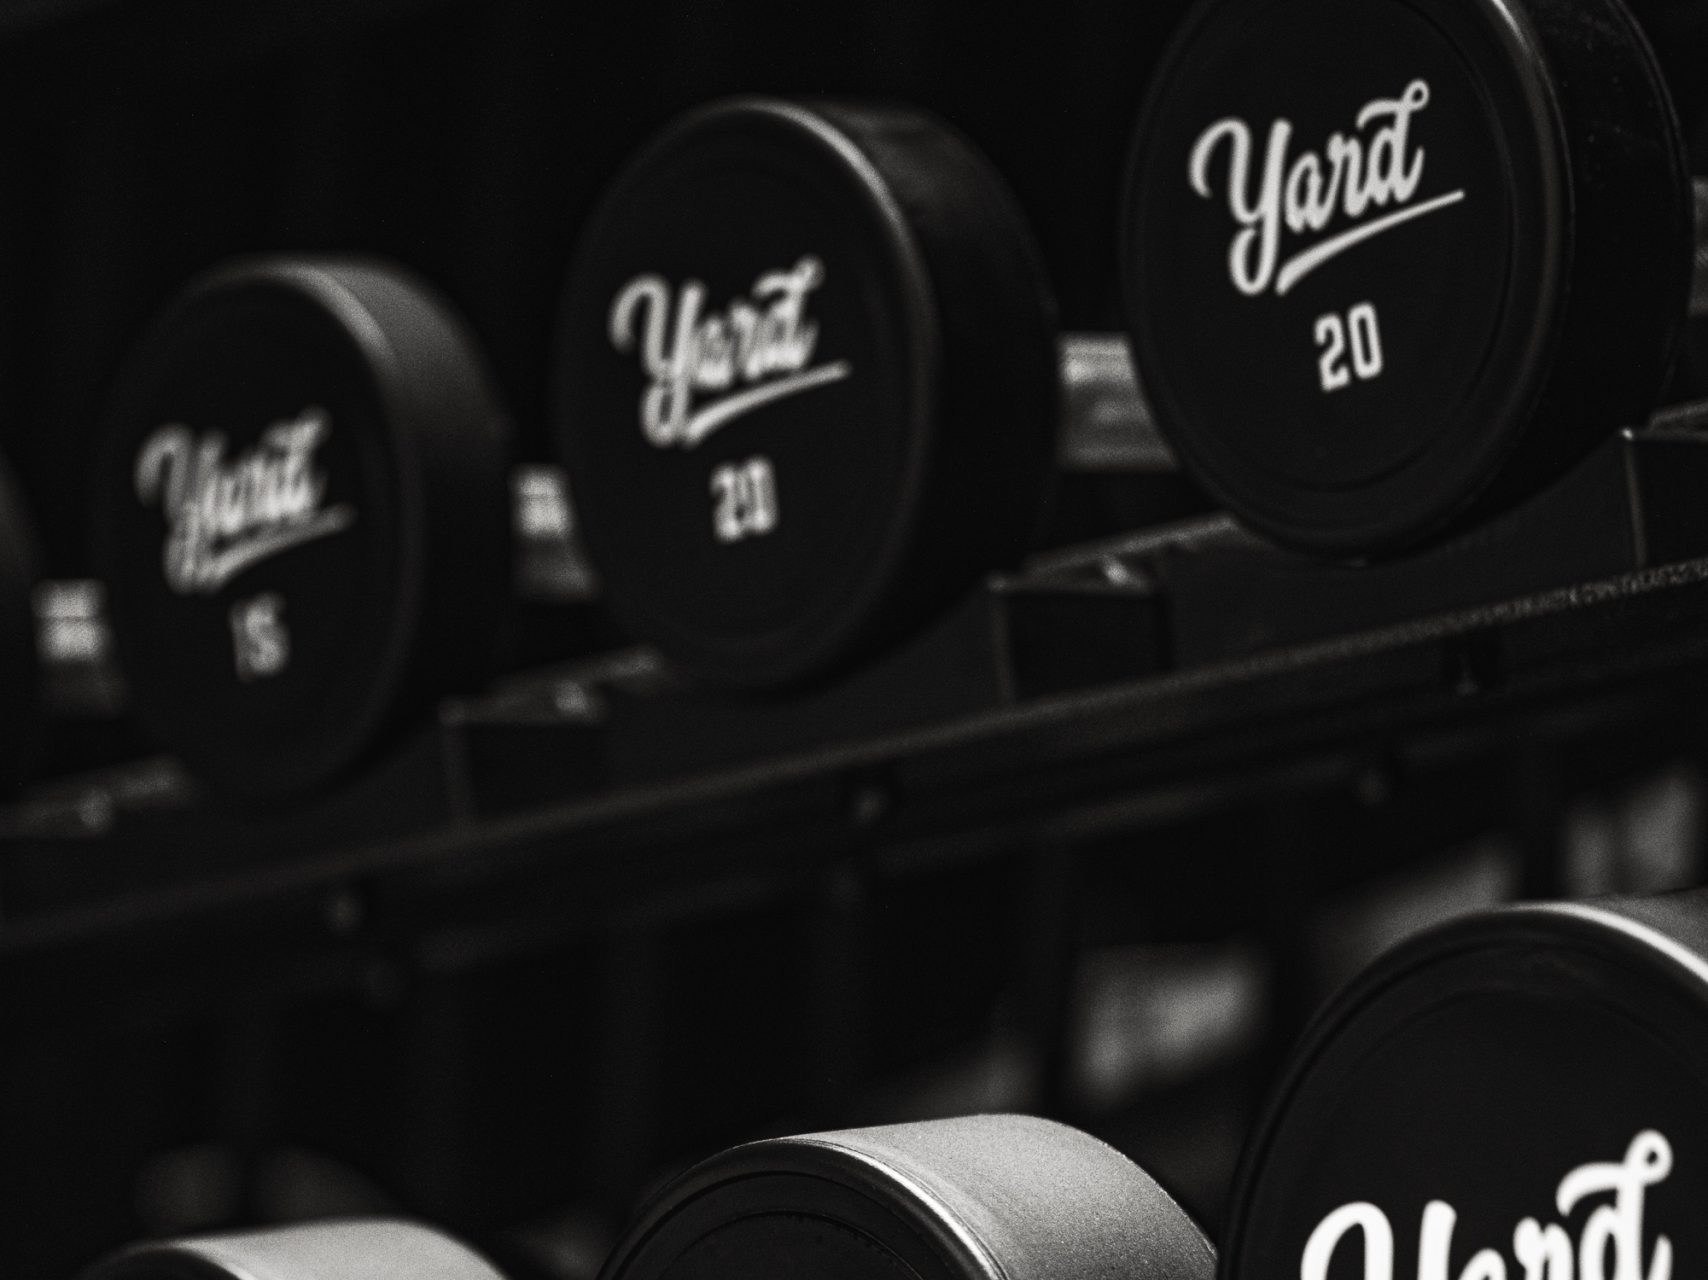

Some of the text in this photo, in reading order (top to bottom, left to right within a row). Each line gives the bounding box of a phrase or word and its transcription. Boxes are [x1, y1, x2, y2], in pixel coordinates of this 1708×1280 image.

[1189, 79, 1430, 295] Yard
[608, 257, 826, 446] Yard
[1314, 303, 1383, 391] 20
[711, 456, 779, 543] 20
